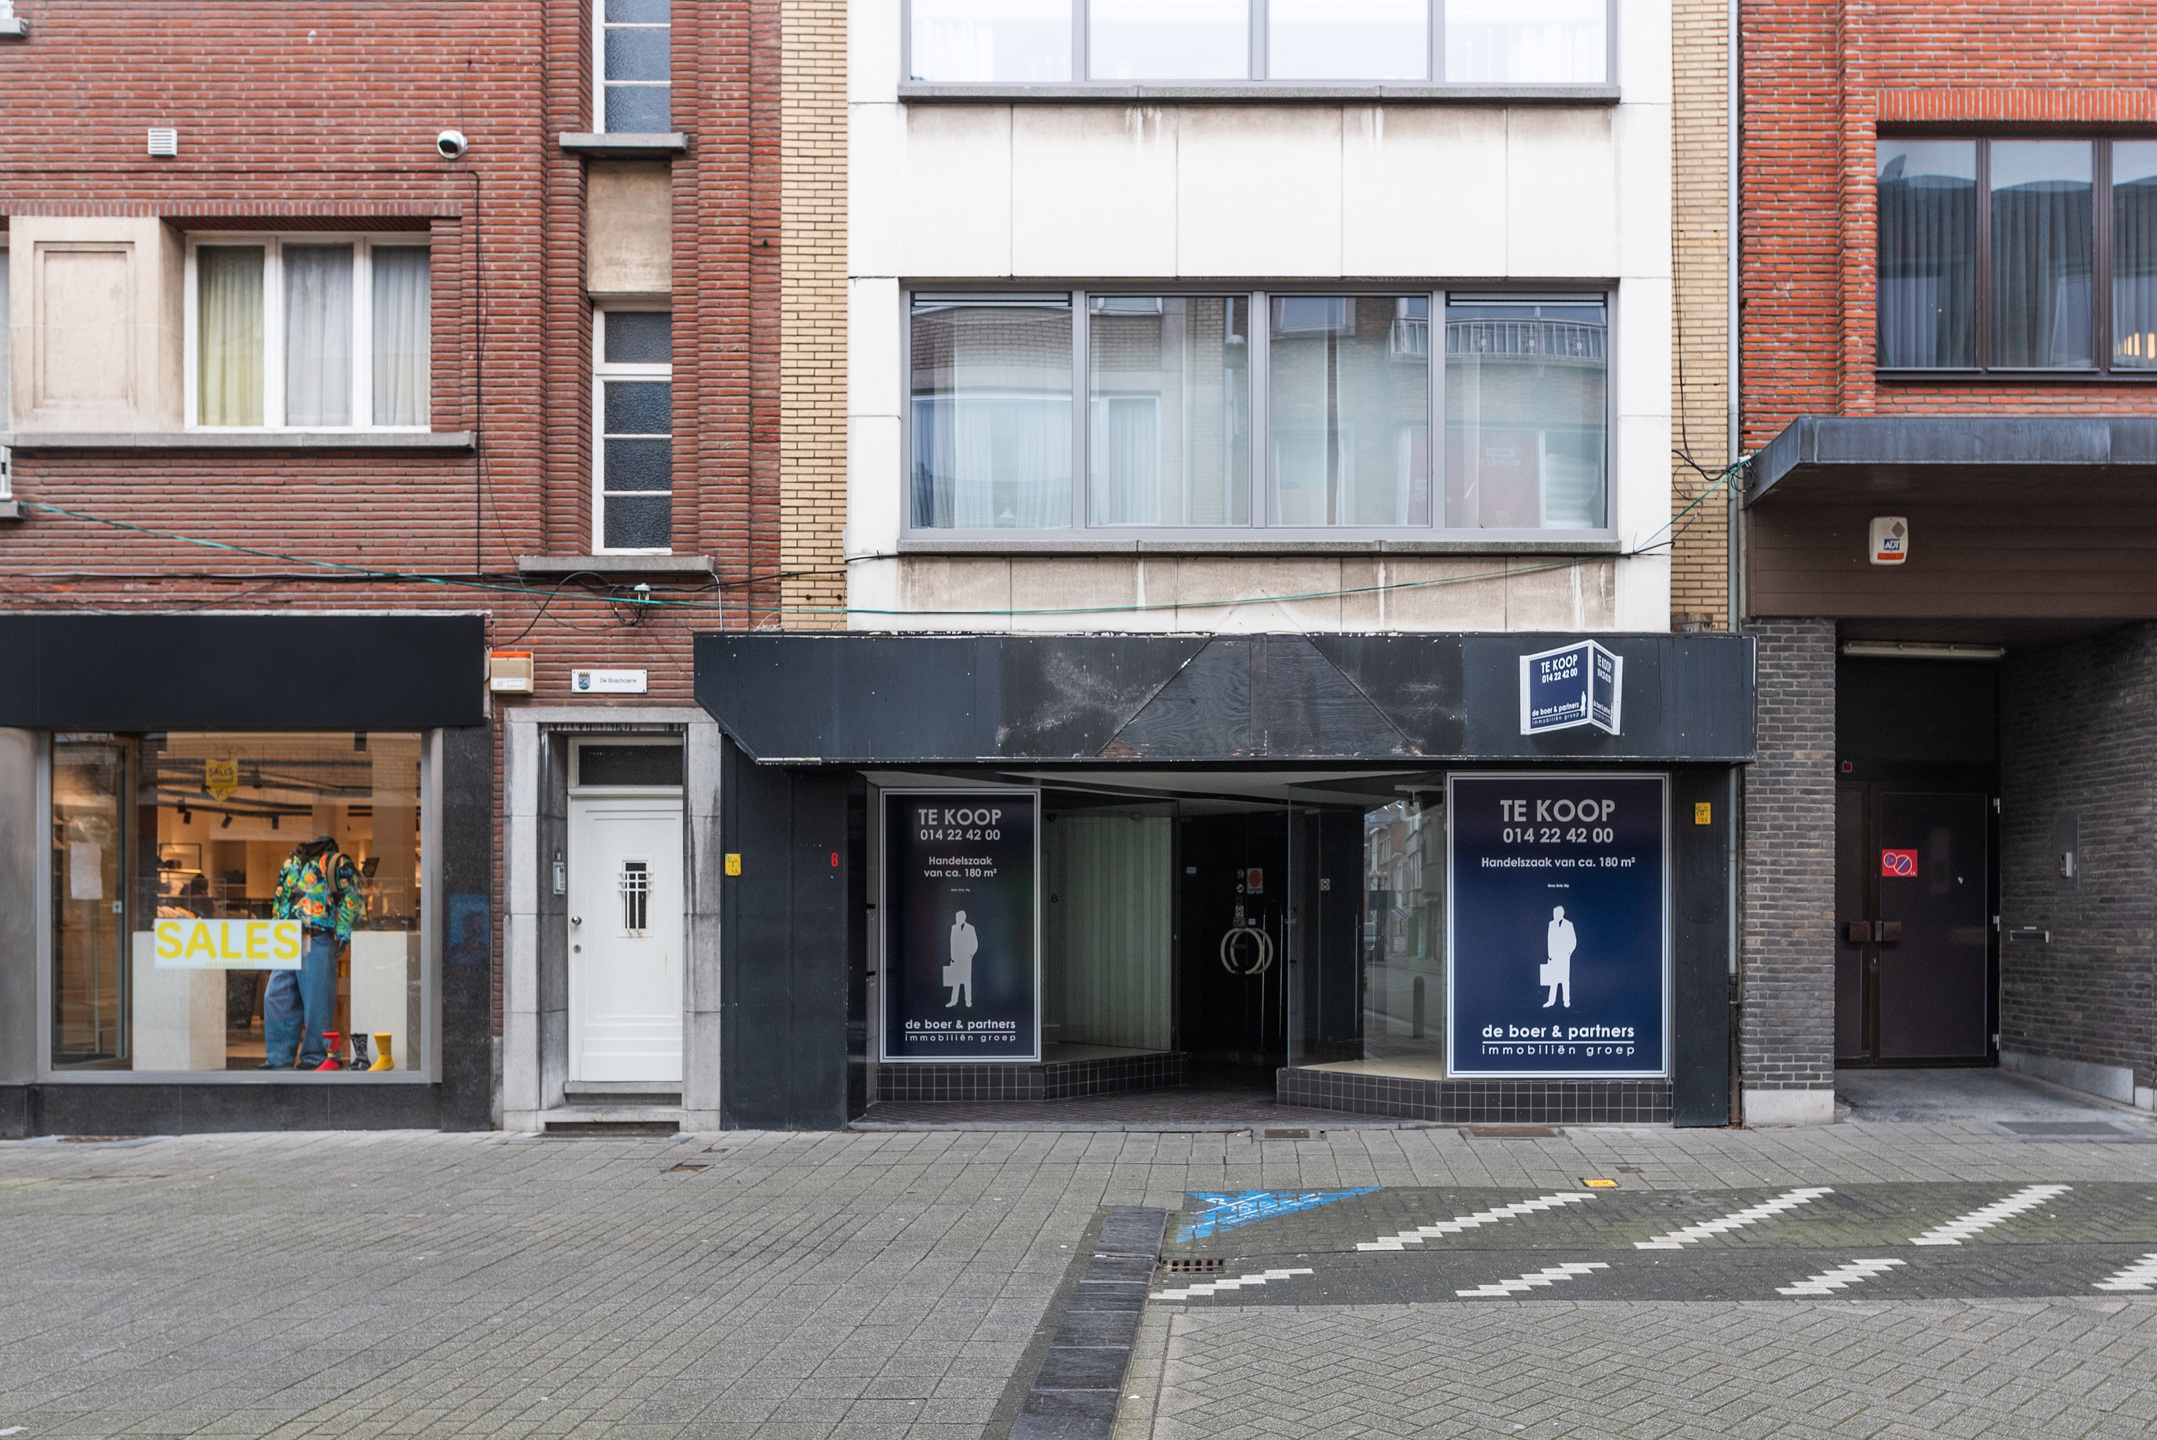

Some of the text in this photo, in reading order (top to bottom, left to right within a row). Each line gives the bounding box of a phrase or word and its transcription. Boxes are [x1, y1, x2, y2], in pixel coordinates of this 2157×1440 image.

[1884, 540, 1901, 550] ADT
[1541, 655, 1578, 674] TE KOOP
[1542, 668, 1578, 684] 014 22 42 00
[1541, 708, 1553, 716] boer
[1559, 702, 1580, 713] partners
[918, 808, 1002, 826] TE KOOP
[1500, 799, 1616, 823] TE KOOP
[920, 829, 1001, 841] 014 22 42 00
[1502, 828, 1614, 844] 014 22 42 00
[831, 852, 839, 867] 8
[928, 856, 993, 866] Handelszaak
[1481, 856, 1636, 868] Handelszaak van ca. 180 m²
[923, 868, 998, 878] van ca. 180 m²
[156, 921, 300, 960] SALES
[905, 1019, 1016, 1031] de boer & partners
[1482, 1024, 1635, 1040] de boer & partners
[905, 1033, 1016, 1043] immobiliën groep
[1482, 1045, 1635, 1057] immobiliën groep
